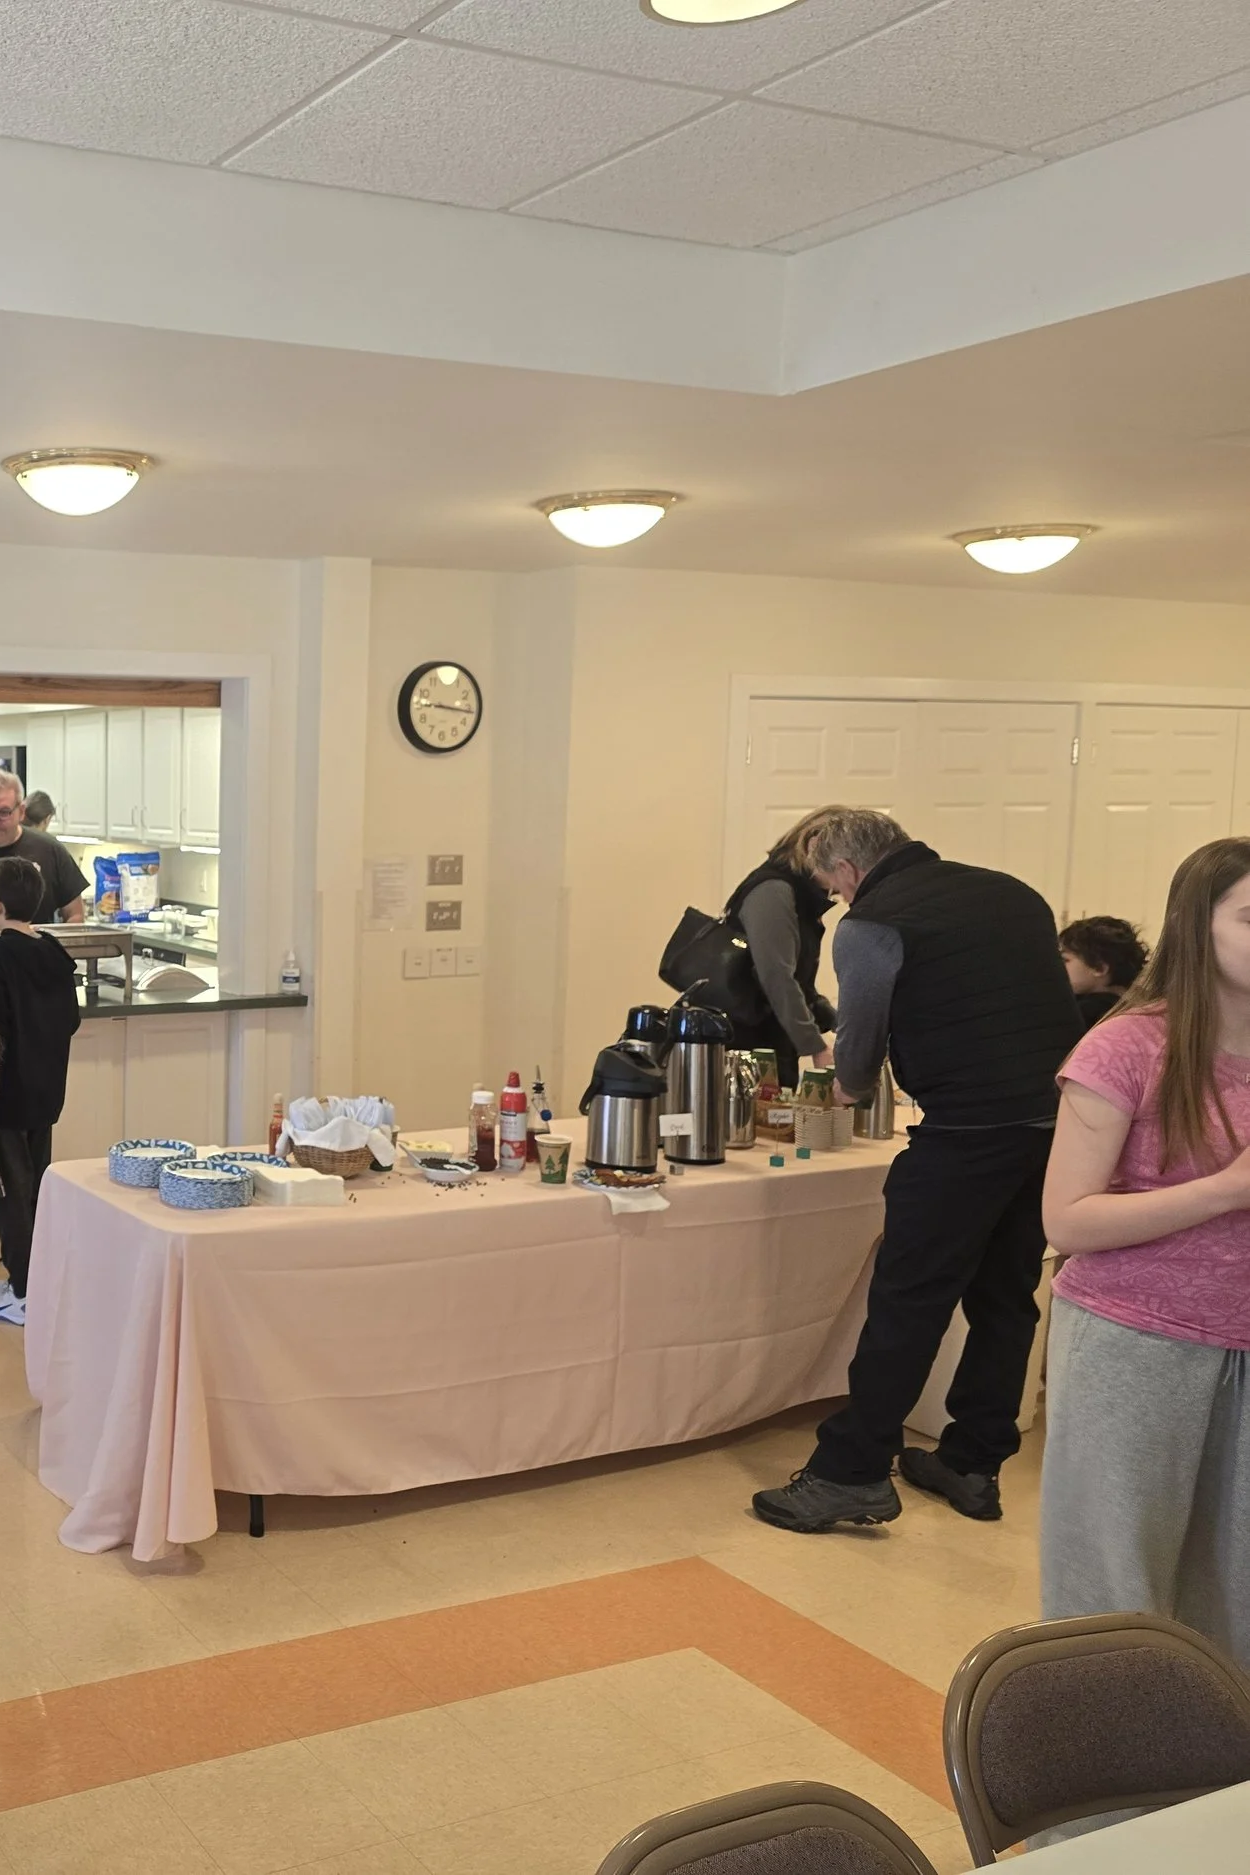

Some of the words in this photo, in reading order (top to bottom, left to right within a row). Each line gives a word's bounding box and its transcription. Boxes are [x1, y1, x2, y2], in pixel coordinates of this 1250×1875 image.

[429, 677, 437, 688] 11
[419, 688, 430, 699] 10
[461, 690, 469, 700] 2
[419, 713, 427, 724] 8
[460, 717, 467, 726] 4
[437, 731, 446, 741] 6
